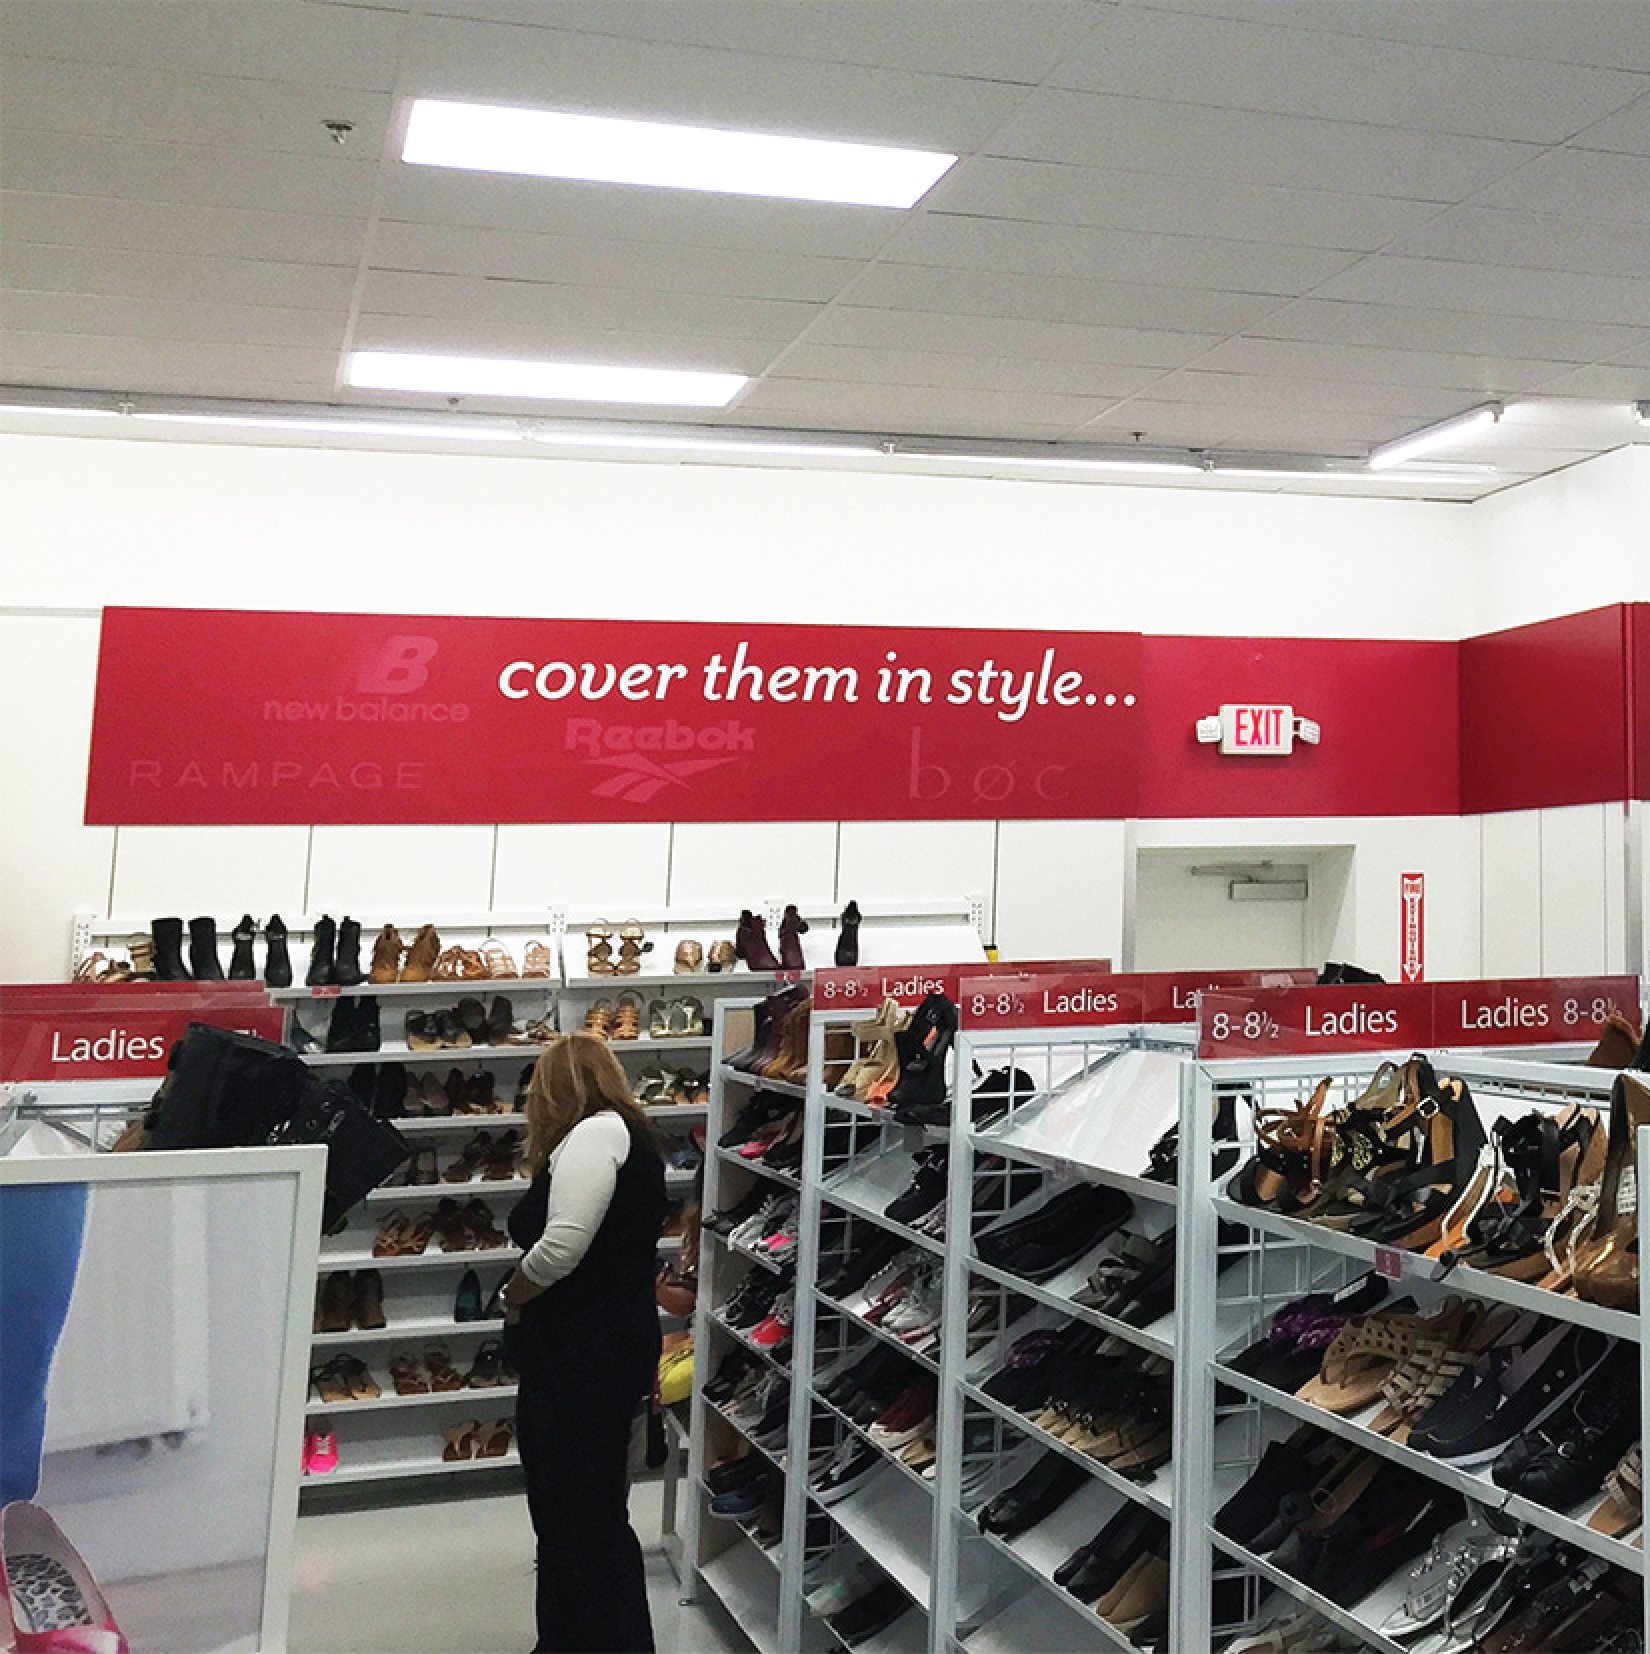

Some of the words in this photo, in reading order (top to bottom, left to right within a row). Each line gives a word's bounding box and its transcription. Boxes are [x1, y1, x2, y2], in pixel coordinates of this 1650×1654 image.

[498, 660, 688, 702] cover
[703, 641, 859, 703] them
[876, 651, 932, 704] in
[947, 648, 1138, 723] style...
[263, 698, 330, 723] new
[335, 696, 470, 724] balance
[1234, 707, 1285, 748] EXIT
[563, 717, 756, 755] Reebok
[128, 761, 425, 790] RAMPAGE
[881, 976, 945, 998] Ladies
[1043, 989, 1118, 1014] Ladies
[1305, 1002, 1398, 1037] Ladies
[1460, 997, 1549, 1029] Ladies
[51, 1028, 165, 1063] Ladies
